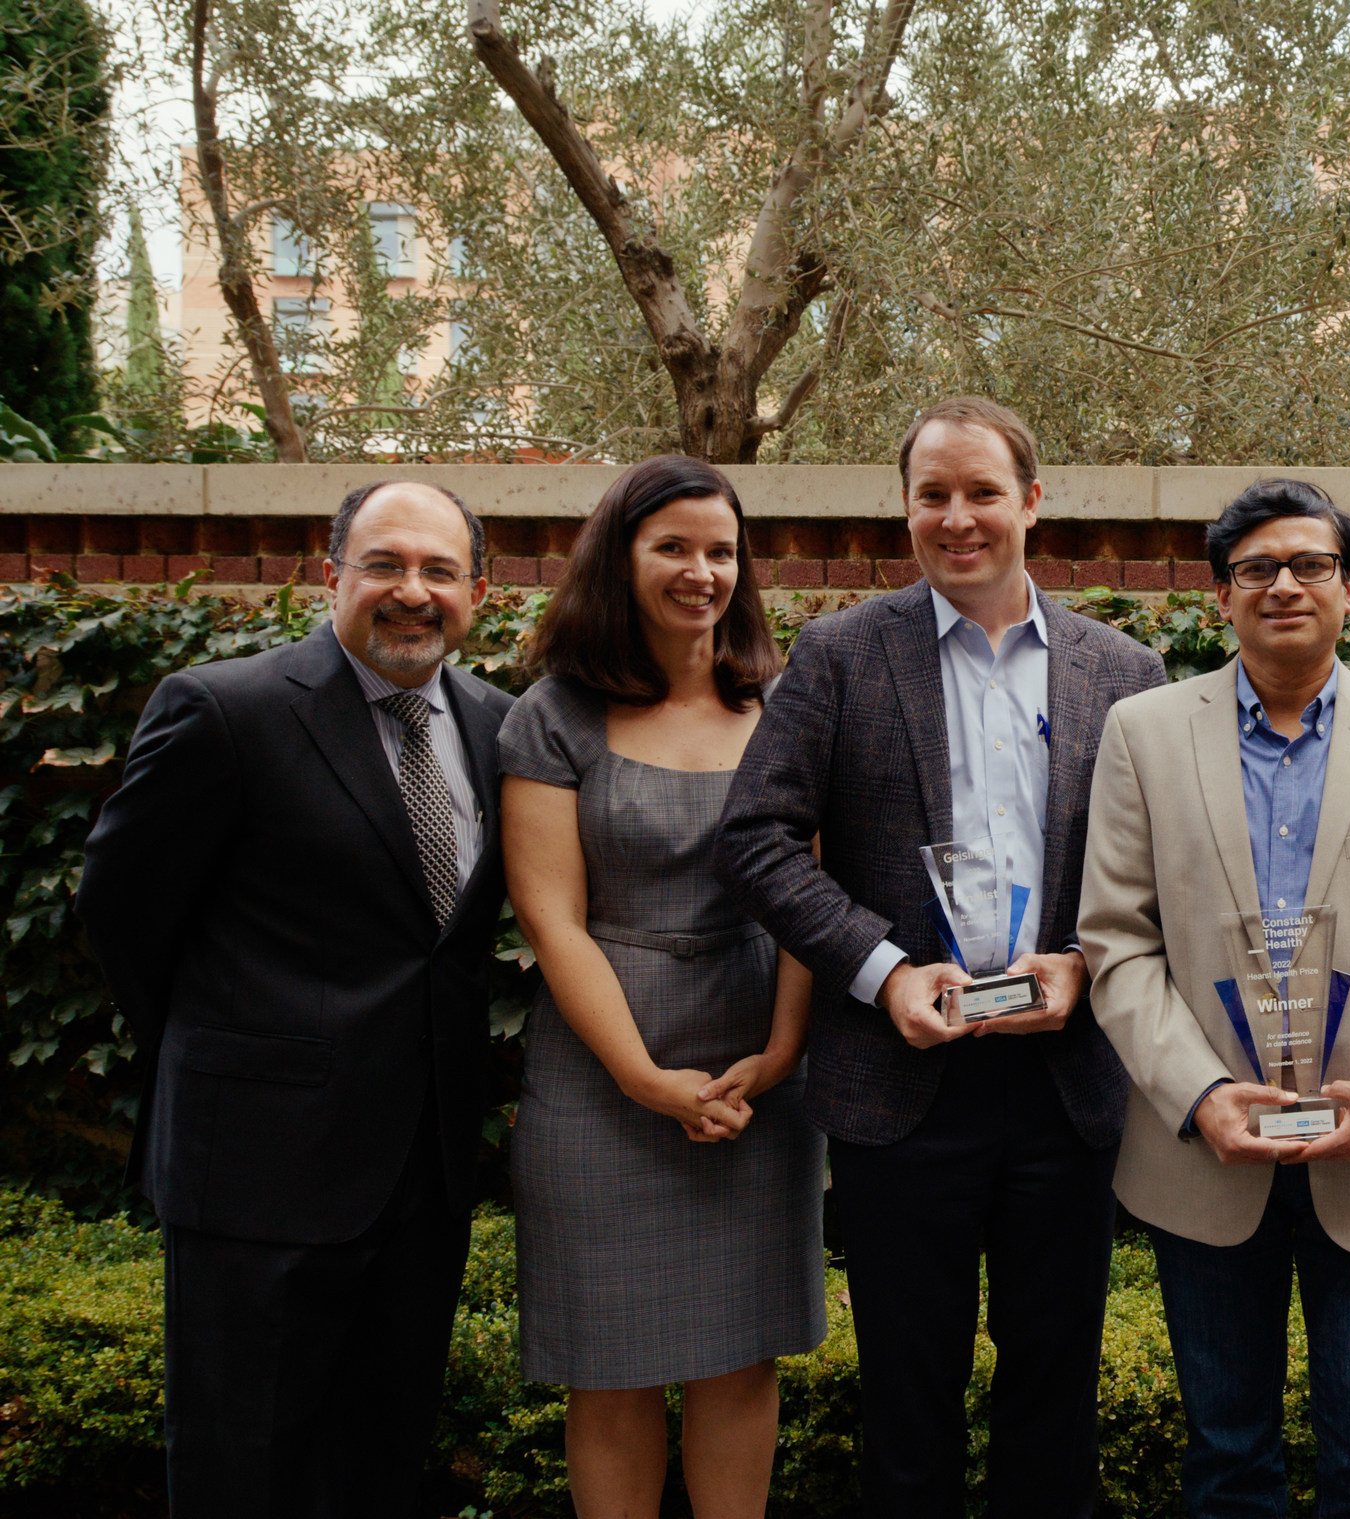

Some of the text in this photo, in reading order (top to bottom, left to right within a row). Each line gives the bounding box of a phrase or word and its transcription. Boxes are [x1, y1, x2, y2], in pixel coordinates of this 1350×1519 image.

[943, 848, 995, 863] Geisinger
[1262, 914, 1314, 928] Constant
[1262, 927, 1308, 939] Therapy
[1265, 938, 1303, 950] Health
[1272, 960, 1291, 969] 2022
[1247, 972, 1272, 981] Hearst
[1273, 969, 1298, 979] Health
[1257, 997, 1314, 1013] Winner
[1277, 1031, 1310, 1039] excellence
[1288, 1038, 1312, 1046] science
